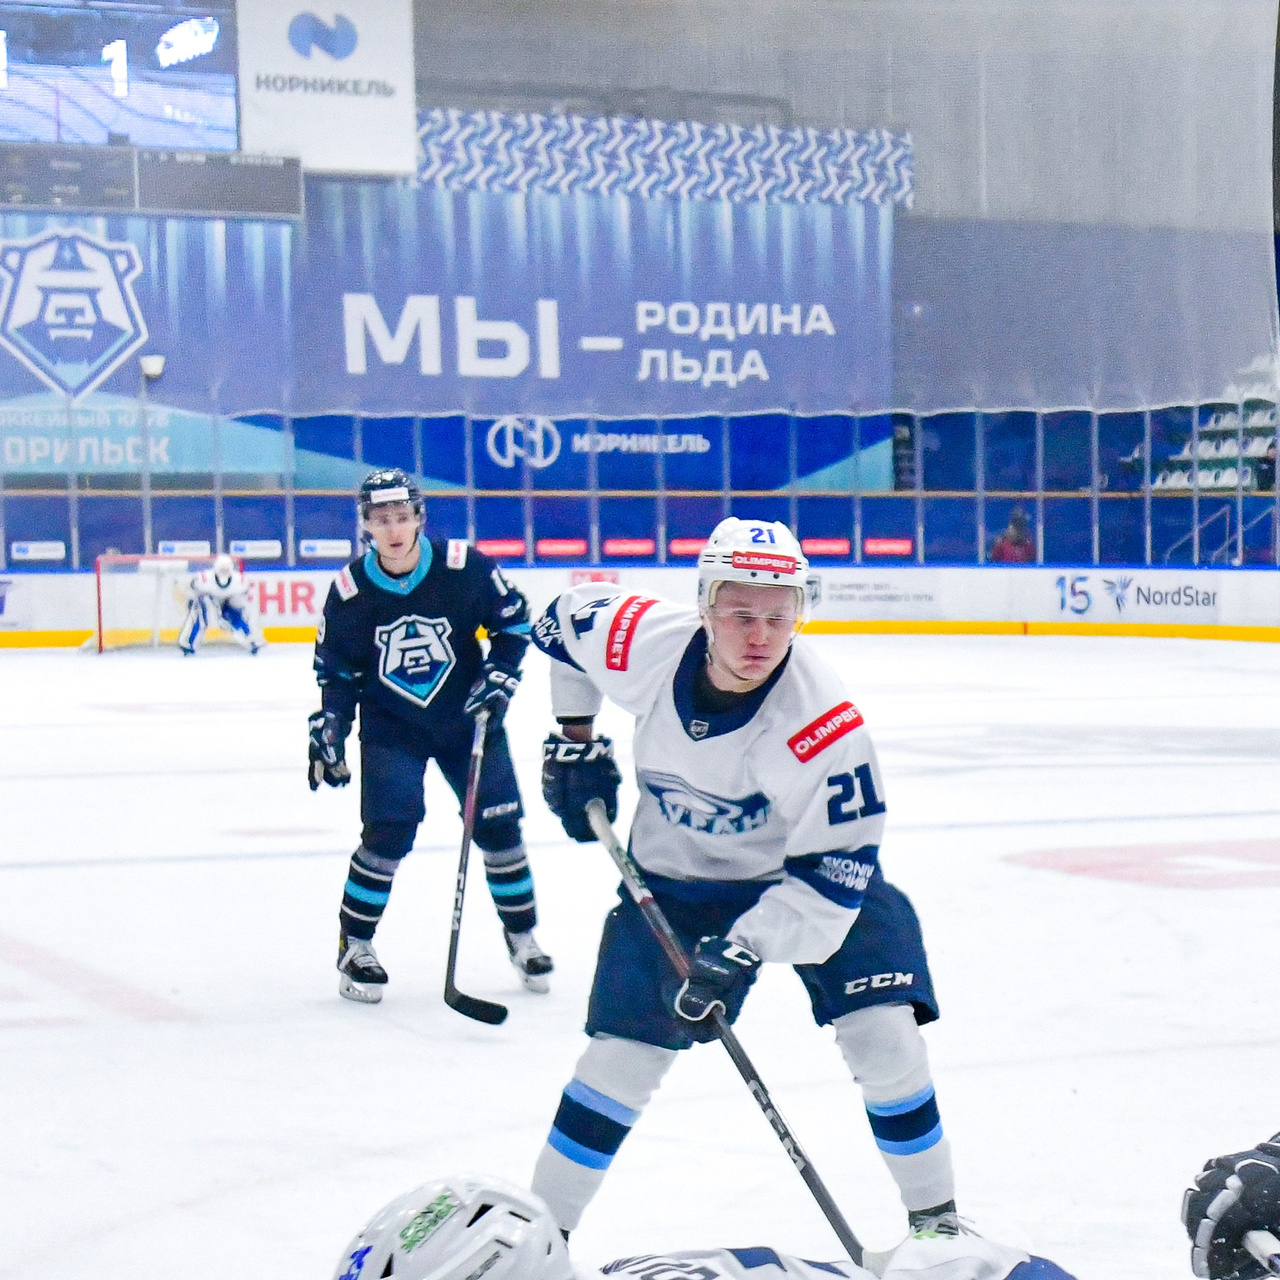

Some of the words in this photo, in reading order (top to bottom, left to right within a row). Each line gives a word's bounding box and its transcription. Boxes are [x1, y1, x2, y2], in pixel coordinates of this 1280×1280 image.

[255, 72, 396, 98] НОРНИКЕЛЬ
[342, 293, 561, 378] МЫ
[635, 301, 836, 337] РОДИНА
[637, 348, 769, 387] ЛЬДА
[750, 527, 776, 545] 21
[733, 554, 796, 572] OLIMPBET
[1055, 576, 1092, 615] 15
[1136, 586, 1218, 607] NordStar
[827, 762, 887, 826] 21
[844, 972, 914, 996] CCM
